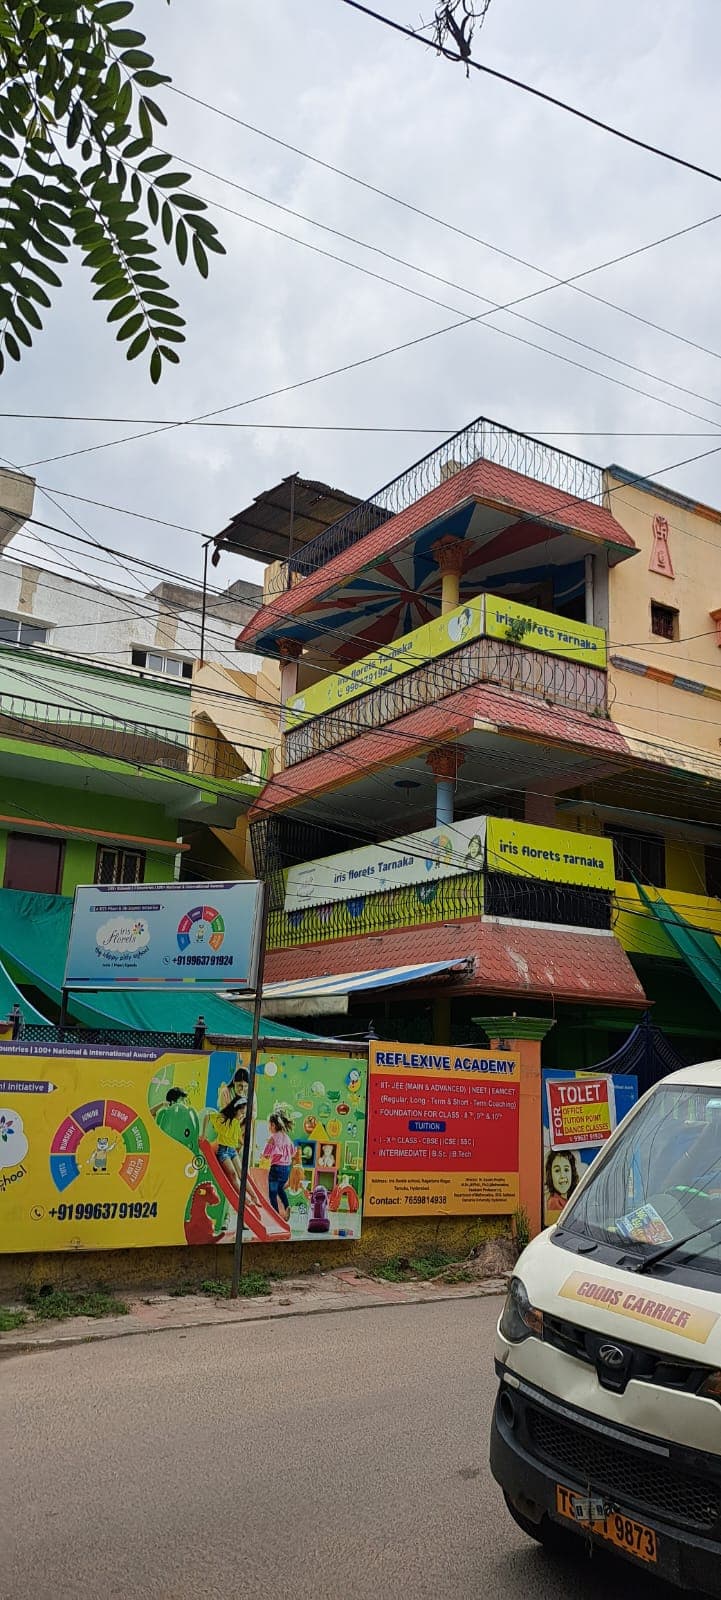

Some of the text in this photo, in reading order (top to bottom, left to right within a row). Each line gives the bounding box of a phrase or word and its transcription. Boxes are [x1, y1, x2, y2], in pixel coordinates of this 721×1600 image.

[499, 839, 604, 869] iris florets Tarnaka
[334, 856, 414, 884] iris florets Tarnaka
[89, 1049, 132, 1058] International
[132, 1050, 158, 1058] Awards
[376, 1052, 515, 1074] REFLEXIVE ACADEMY
[8, 1082, 44, 1091] Initiative
[472, 1086, 487, 1094] NEET
[491, 1088, 516, 1096] EAMCET
[558, 1084, 601, 1104] TOLET
[410, 1096, 426, 1105] Long
[452, 1098, 468, 1106] Short
[380, 1110, 422, 1118] FOUNDATION
[424, 1110, 438, 1118] FOR
[562, 1106, 584, 1114] OFFICE
[553, 1106, 564, 1136] FOR
[563, 1114, 601, 1125] TUTION POINT
[414, 1122, 441, 1130] TUITION
[564, 1122, 609, 1134] DANCE CLASSES
[370, 1196, 402, 1205] Contact:
[576, 1281, 691, 1329] GOODS CARRIER
[614, 1514, 655, 1556] 9873
